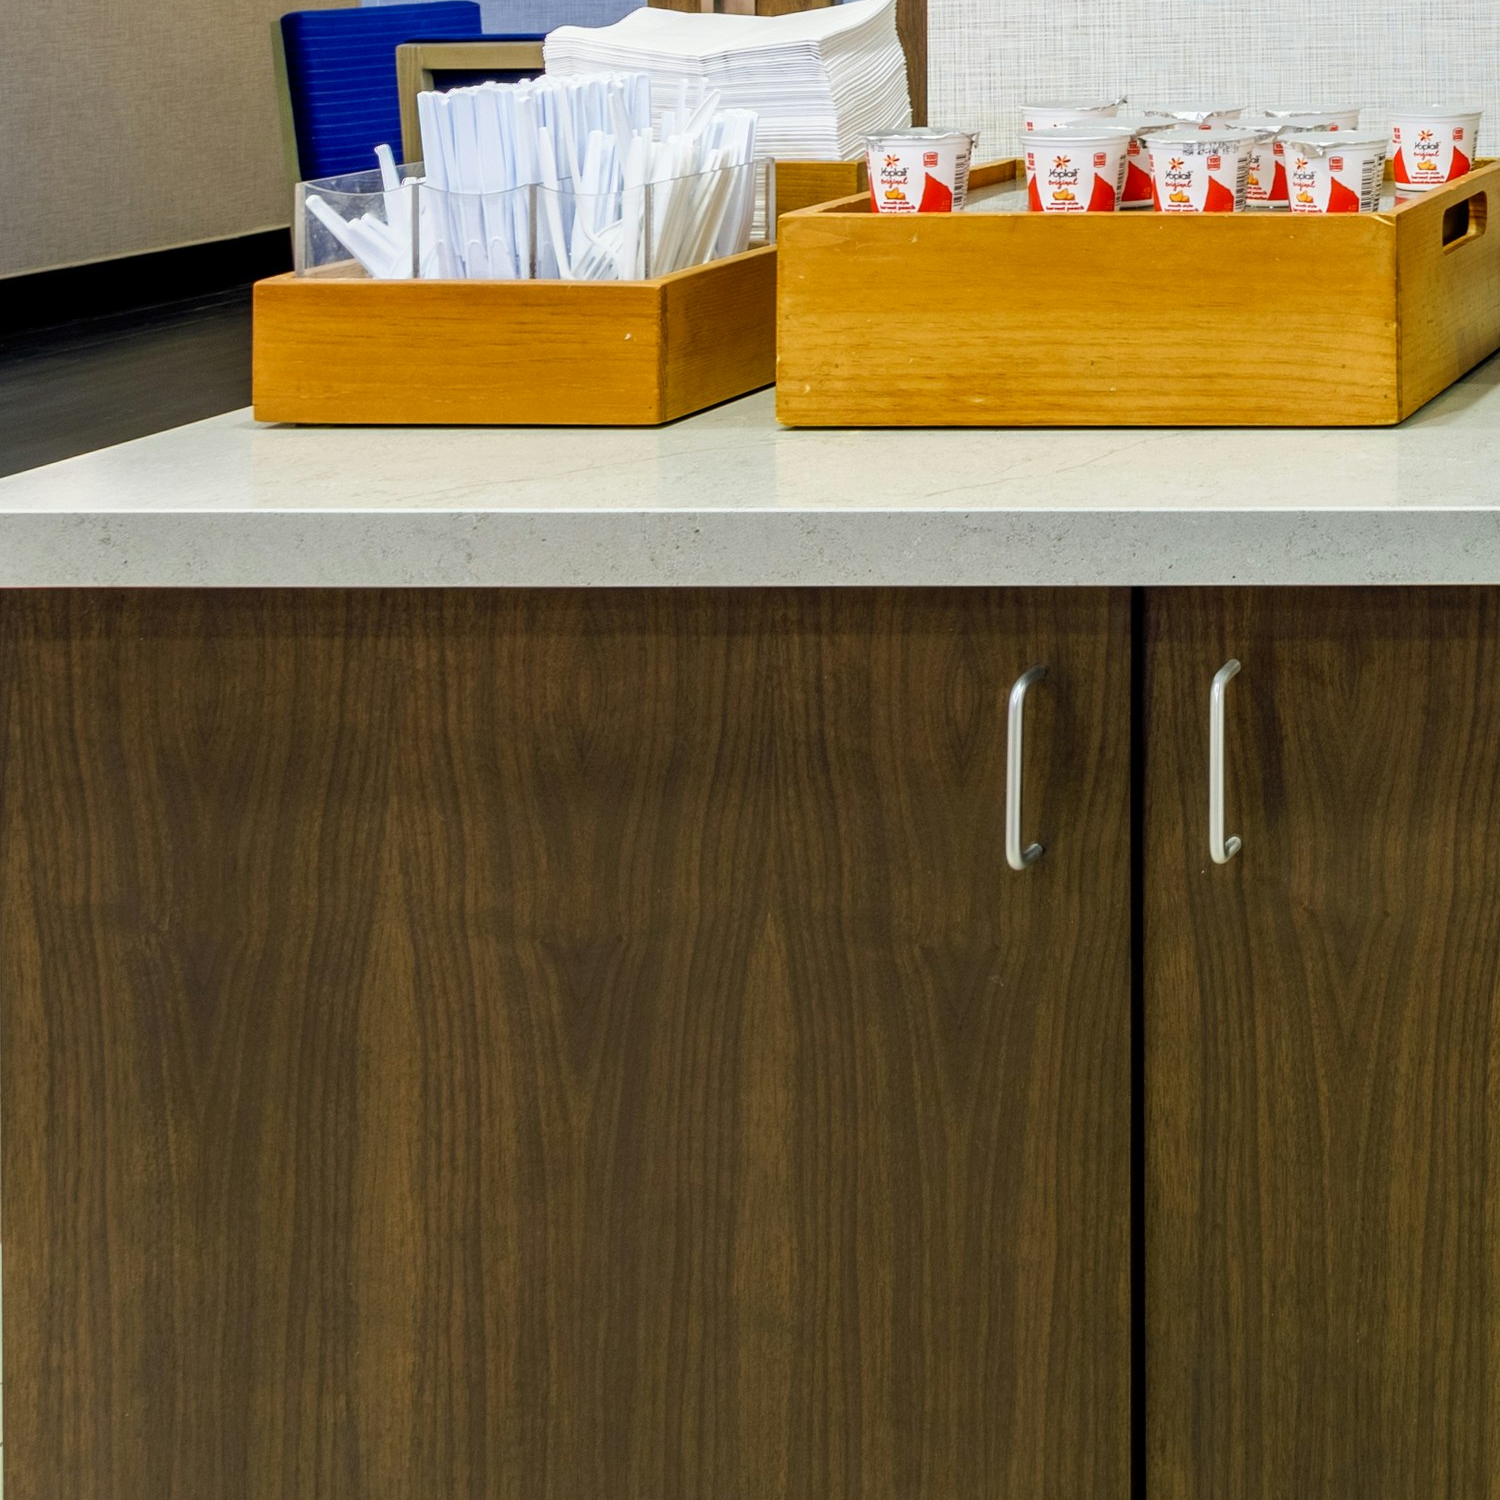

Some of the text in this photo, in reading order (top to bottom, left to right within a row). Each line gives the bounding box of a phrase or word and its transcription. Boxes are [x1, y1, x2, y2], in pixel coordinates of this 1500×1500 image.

[880, 167, 908, 180] Yoplait
[1049, 168, 1079, 179] Yoplait
[1165, 170, 1192, 181] Yoplait
